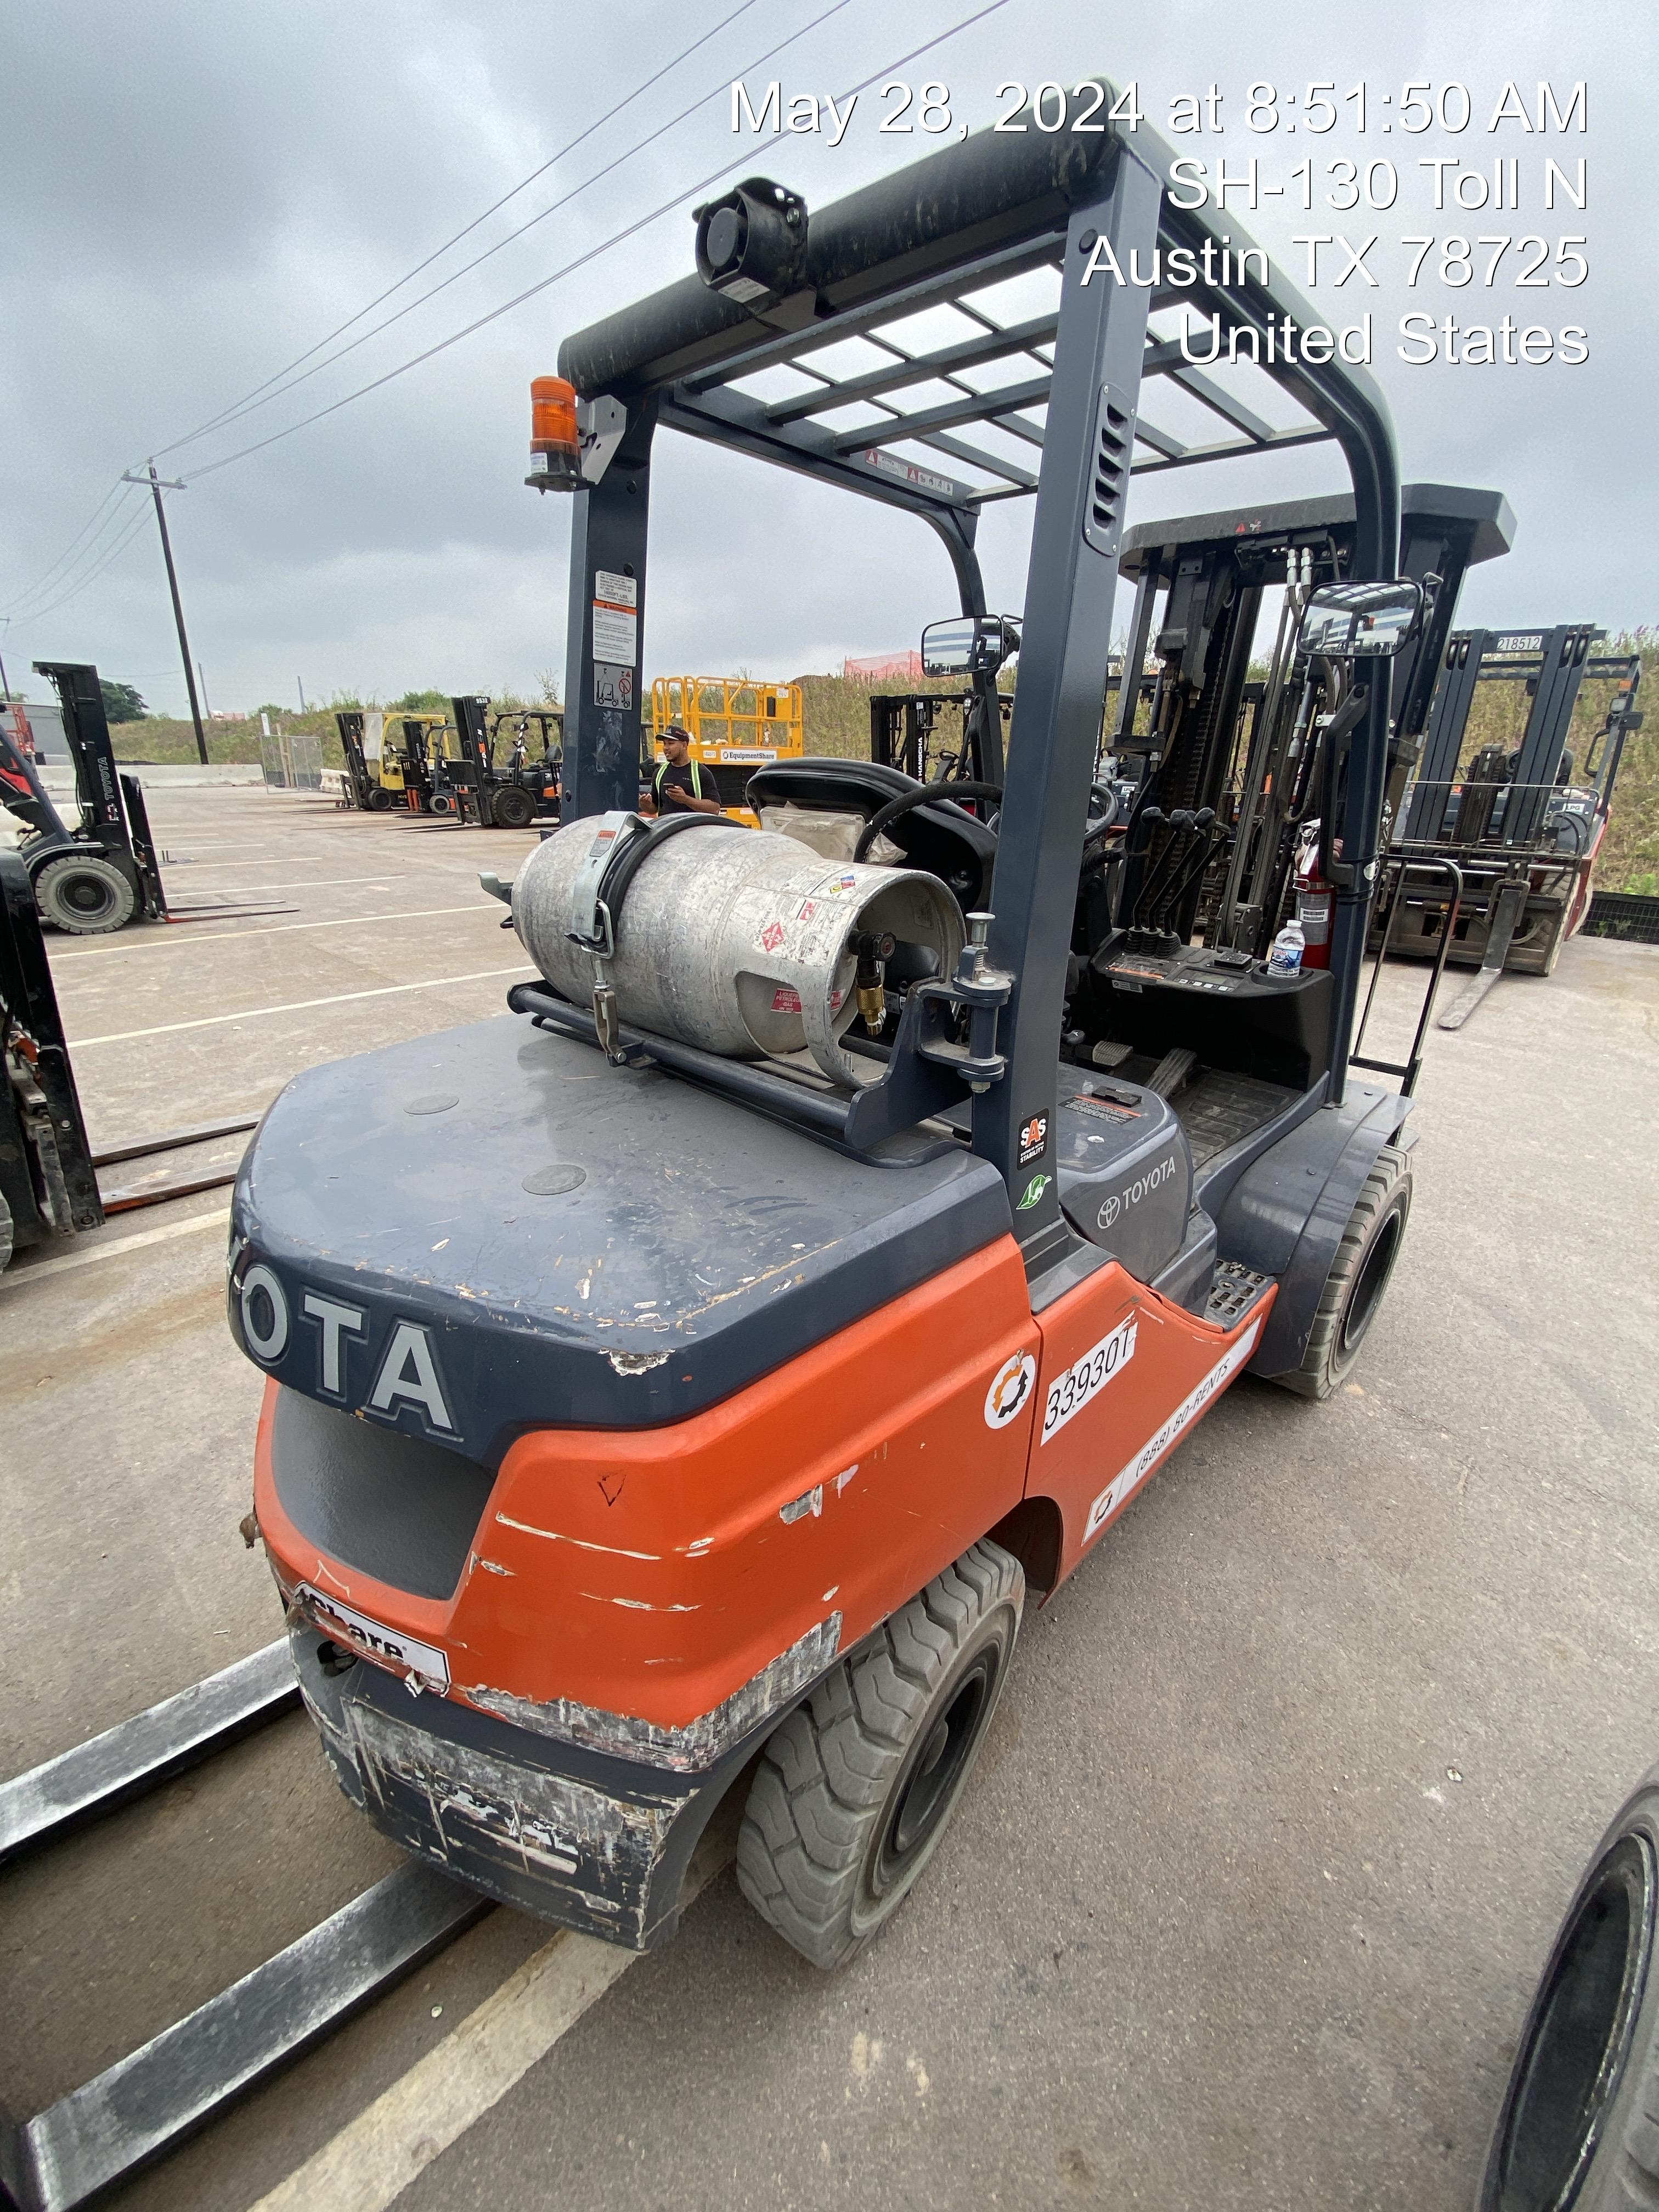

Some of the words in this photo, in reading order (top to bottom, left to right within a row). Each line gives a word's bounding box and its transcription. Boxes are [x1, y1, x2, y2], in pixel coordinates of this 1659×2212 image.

[1497, 637, 1541, 650] 218512
[98, 757, 115, 800] TOYOTA
[1020, 1118, 1046, 1149] SAS
[1020, 1145, 1045, 1163] STABILITY
[1122, 1156, 1176, 1210] TOYOTA
[1136, 1426, 1170, 1477] (888)
[1173, 1358, 1230, 1433] 80-RENTS
